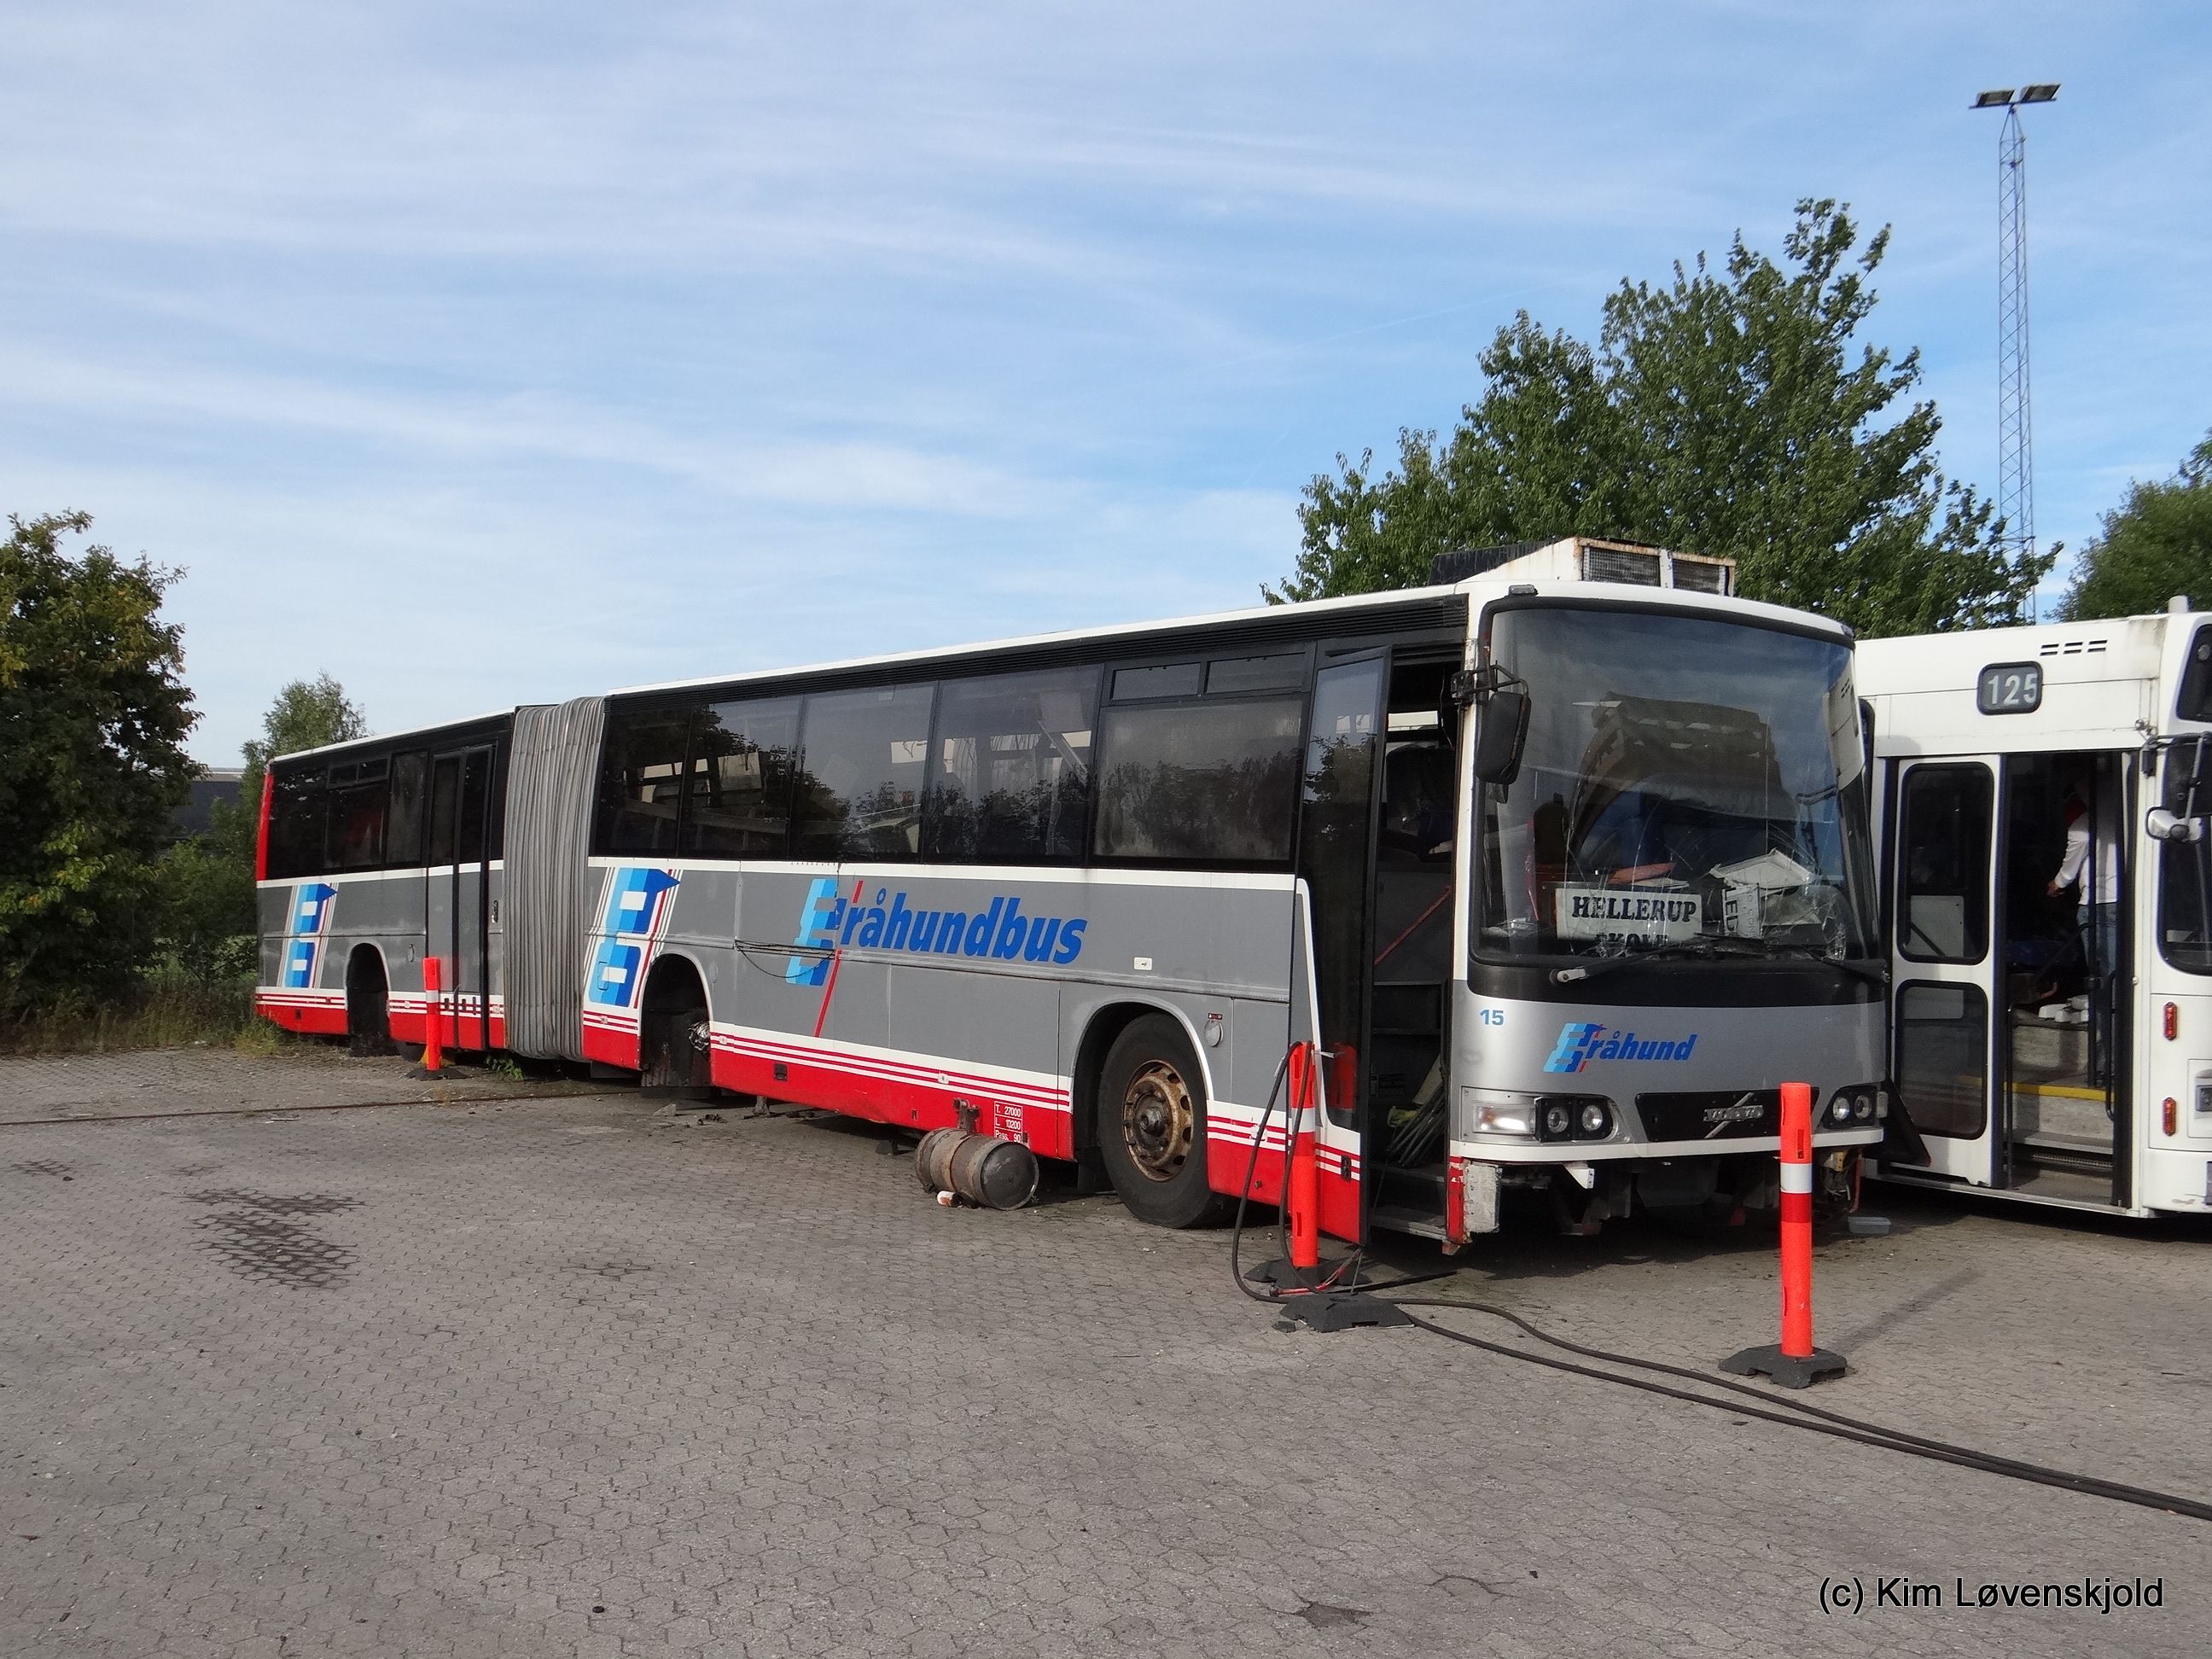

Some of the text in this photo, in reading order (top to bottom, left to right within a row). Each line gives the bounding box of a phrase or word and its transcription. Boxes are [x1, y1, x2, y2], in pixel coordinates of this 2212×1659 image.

[1988, 673, 2038, 706] 125
[1571, 896, 1697, 923] HELLERUP
[1479, 1009, 1505, 1026] 15
[1004, 1106, 1021, 1117] 27000
[1005, 1120, 1021, 1130] 10200
[1013, 1133, 1021, 1143] 90
